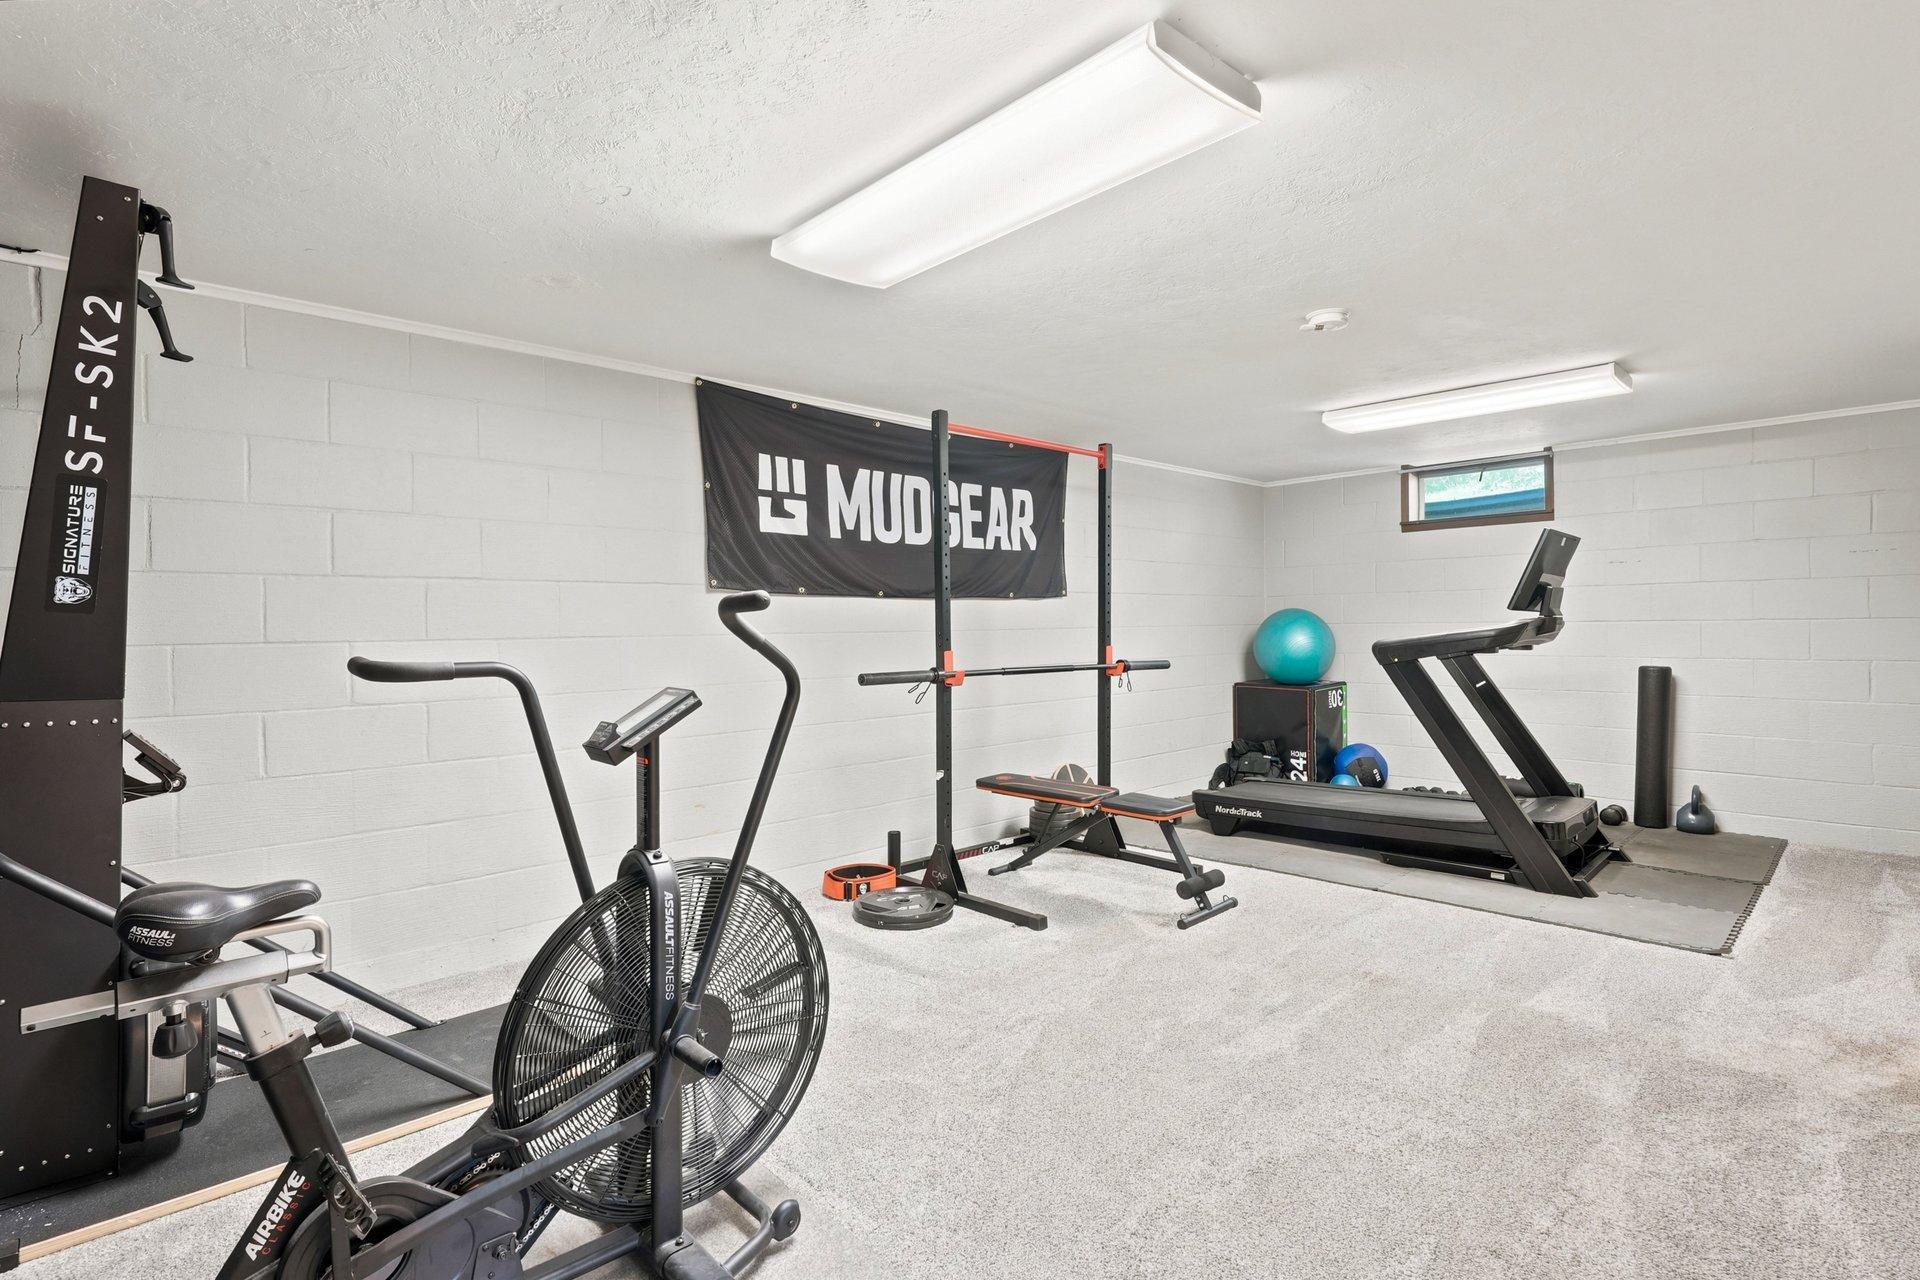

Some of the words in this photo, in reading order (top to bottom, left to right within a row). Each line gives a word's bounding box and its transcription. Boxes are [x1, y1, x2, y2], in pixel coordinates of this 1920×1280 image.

[64, 295, 122, 474] SF-SK2
[62, 484, 83, 574] SIGNATURE
[79, 491, 96, 571] FITNESS
[1290, 758, 1308, 782] 24
[1215, 805, 1262, 818] NordicTrack
[982, 844, 1000, 854] CAP
[128, 932, 175, 947] FITNESS
[663, 890, 675, 947] ASSAULT
[665, 947, 675, 1001] FITNESS
[245, 1169, 306, 1261] AIRBIKE
[260, 1182, 311, 1255] CLASSIC
